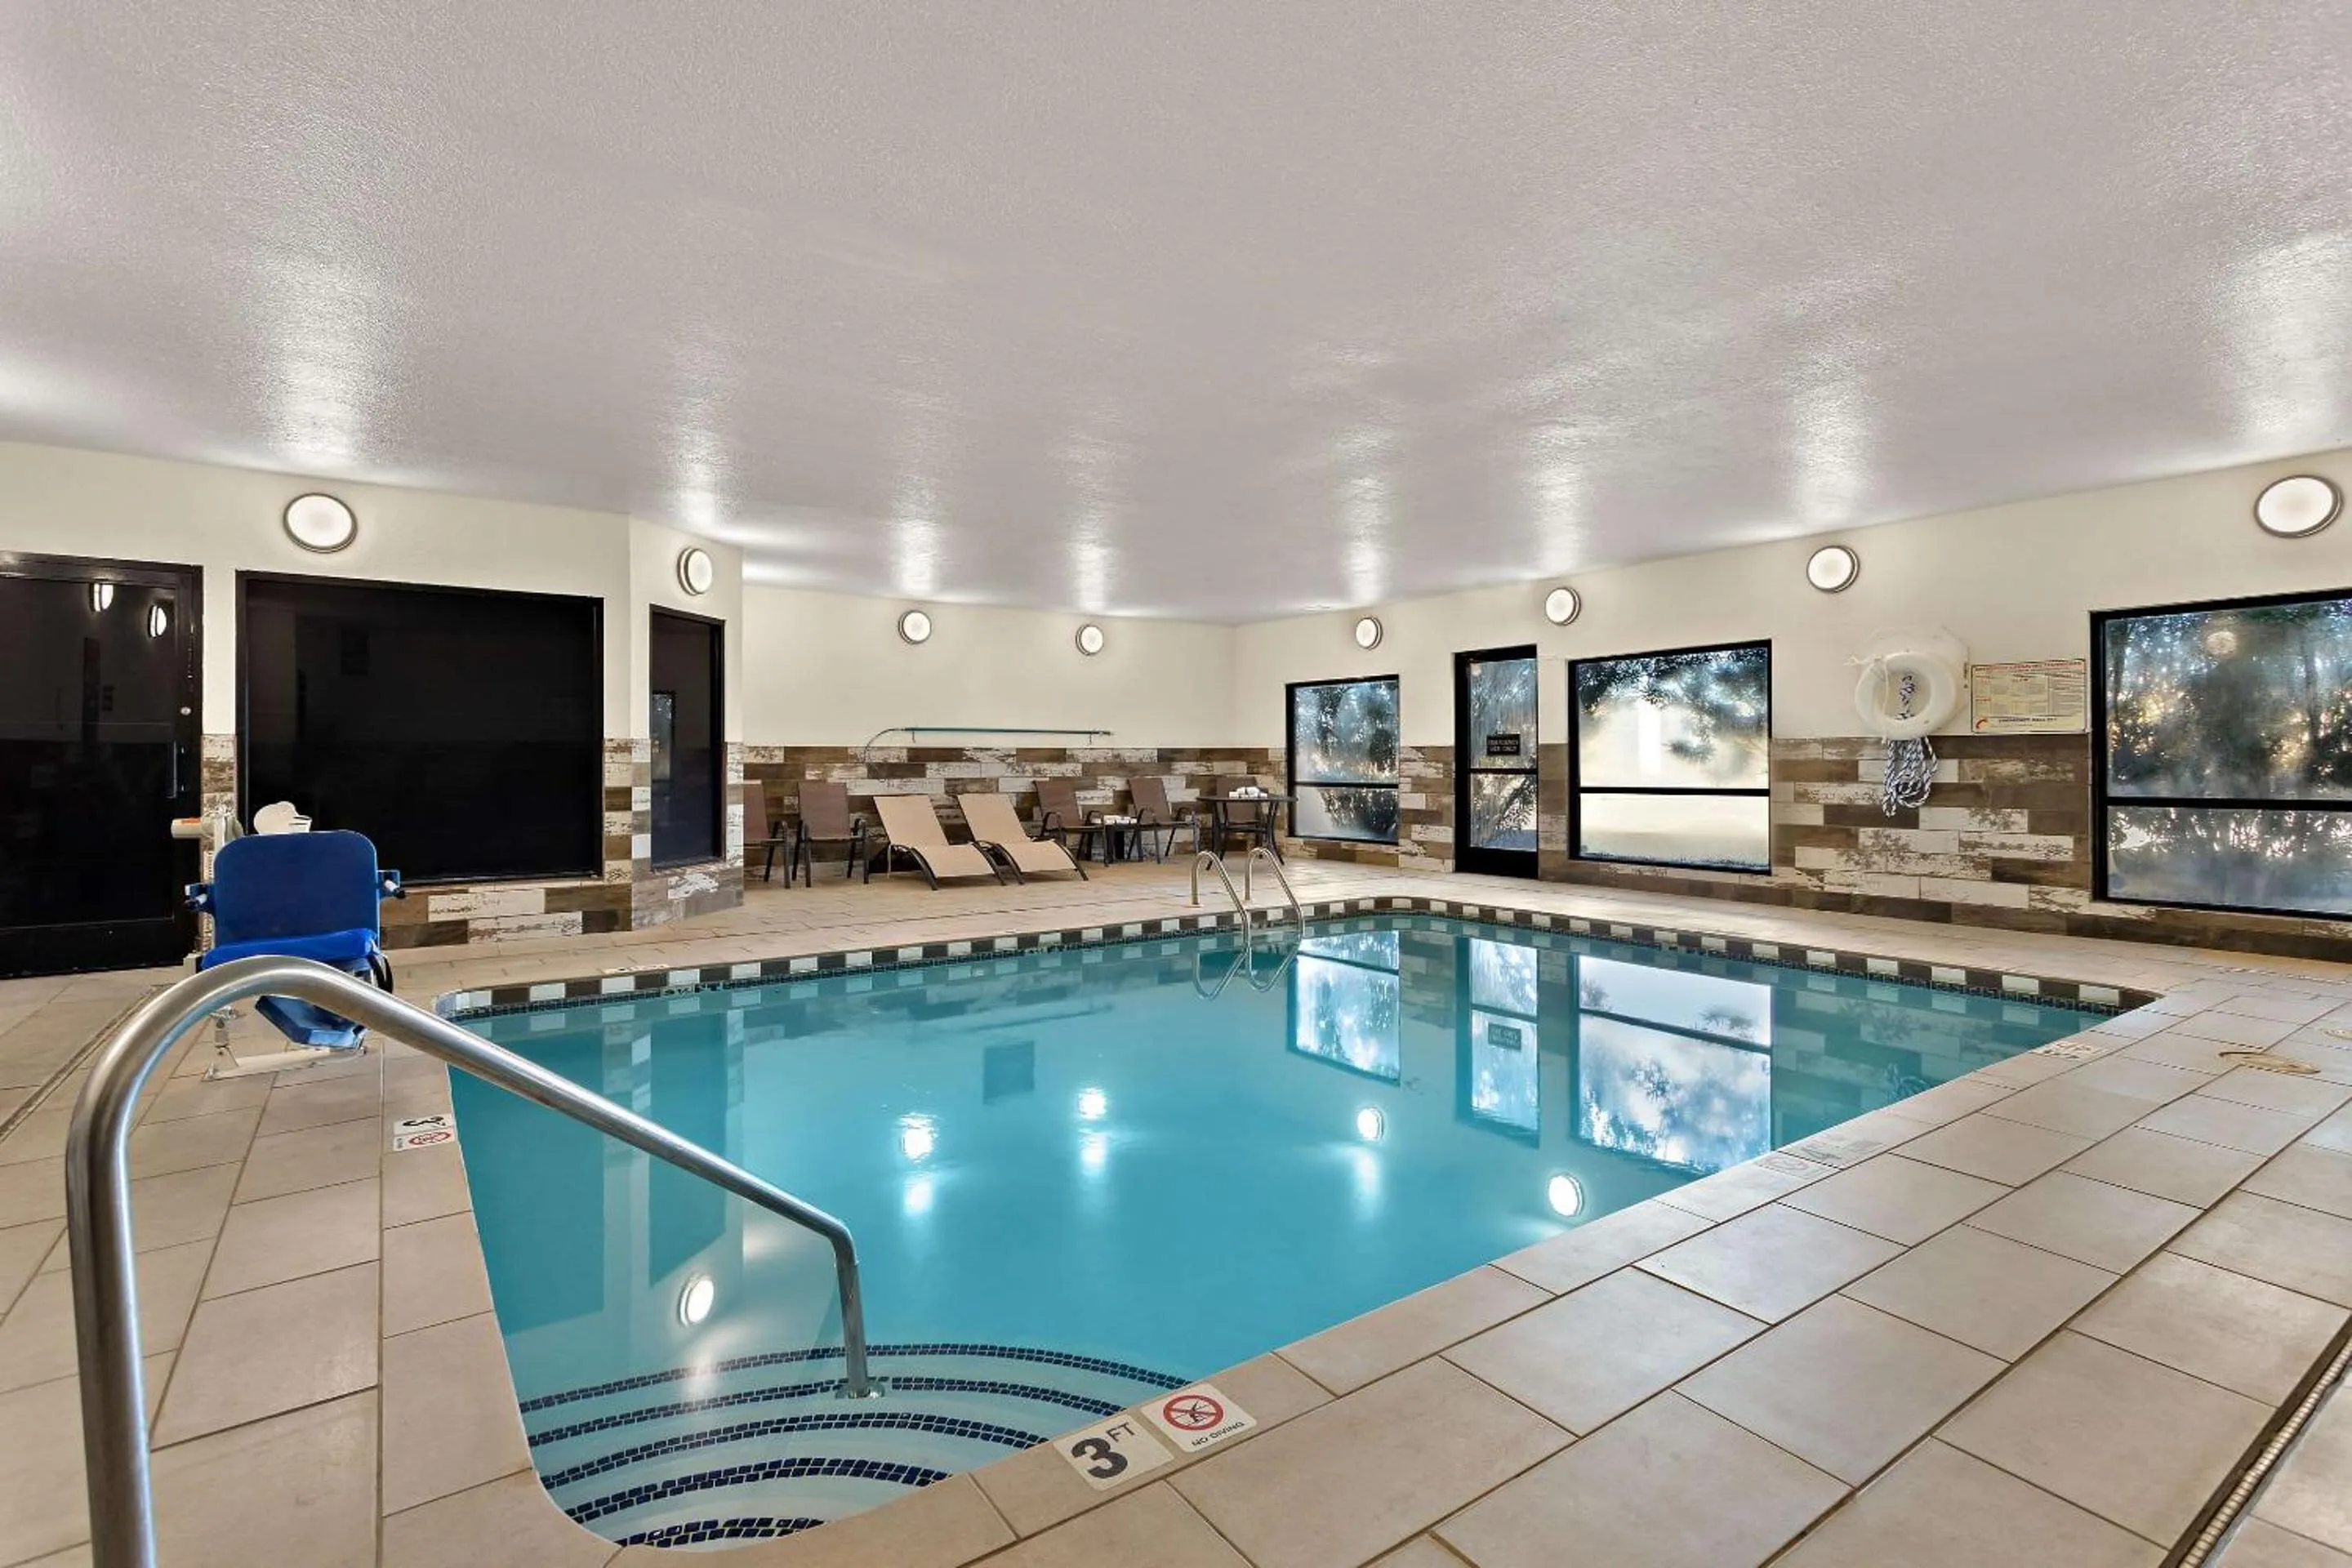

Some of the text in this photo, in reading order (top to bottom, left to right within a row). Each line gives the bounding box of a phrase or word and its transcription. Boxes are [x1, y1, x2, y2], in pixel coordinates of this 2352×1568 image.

[1071, 1422, 1135, 1479] 3 FT
[1192, 1422, 1245, 1446] NO DIVING
